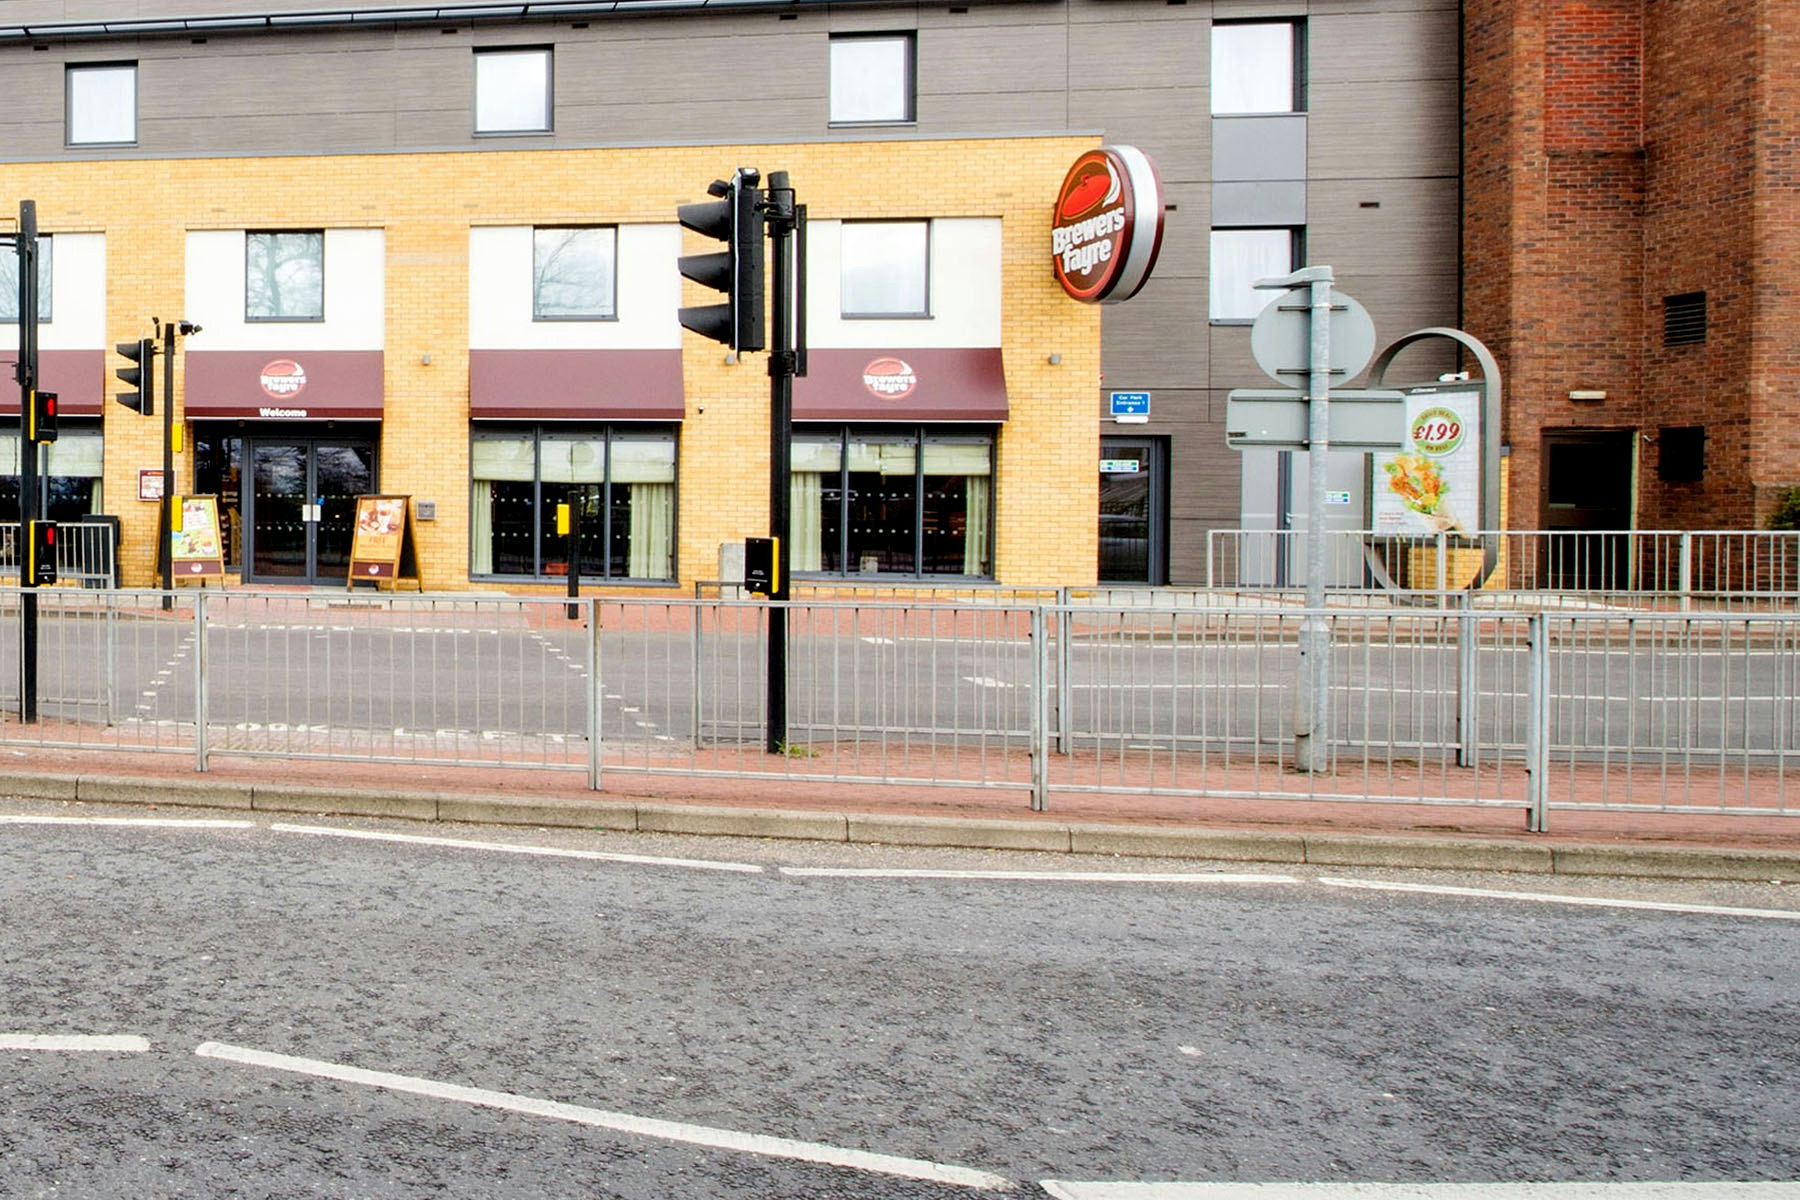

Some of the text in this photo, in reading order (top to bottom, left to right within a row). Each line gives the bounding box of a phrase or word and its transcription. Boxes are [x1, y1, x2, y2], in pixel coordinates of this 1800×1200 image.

[1052, 207, 1126, 255] Brewers
[1062, 238, 1112, 275] fayre
[259, 407, 307, 417] Welcome
[1413, 422, 1460, 441] £1.99
